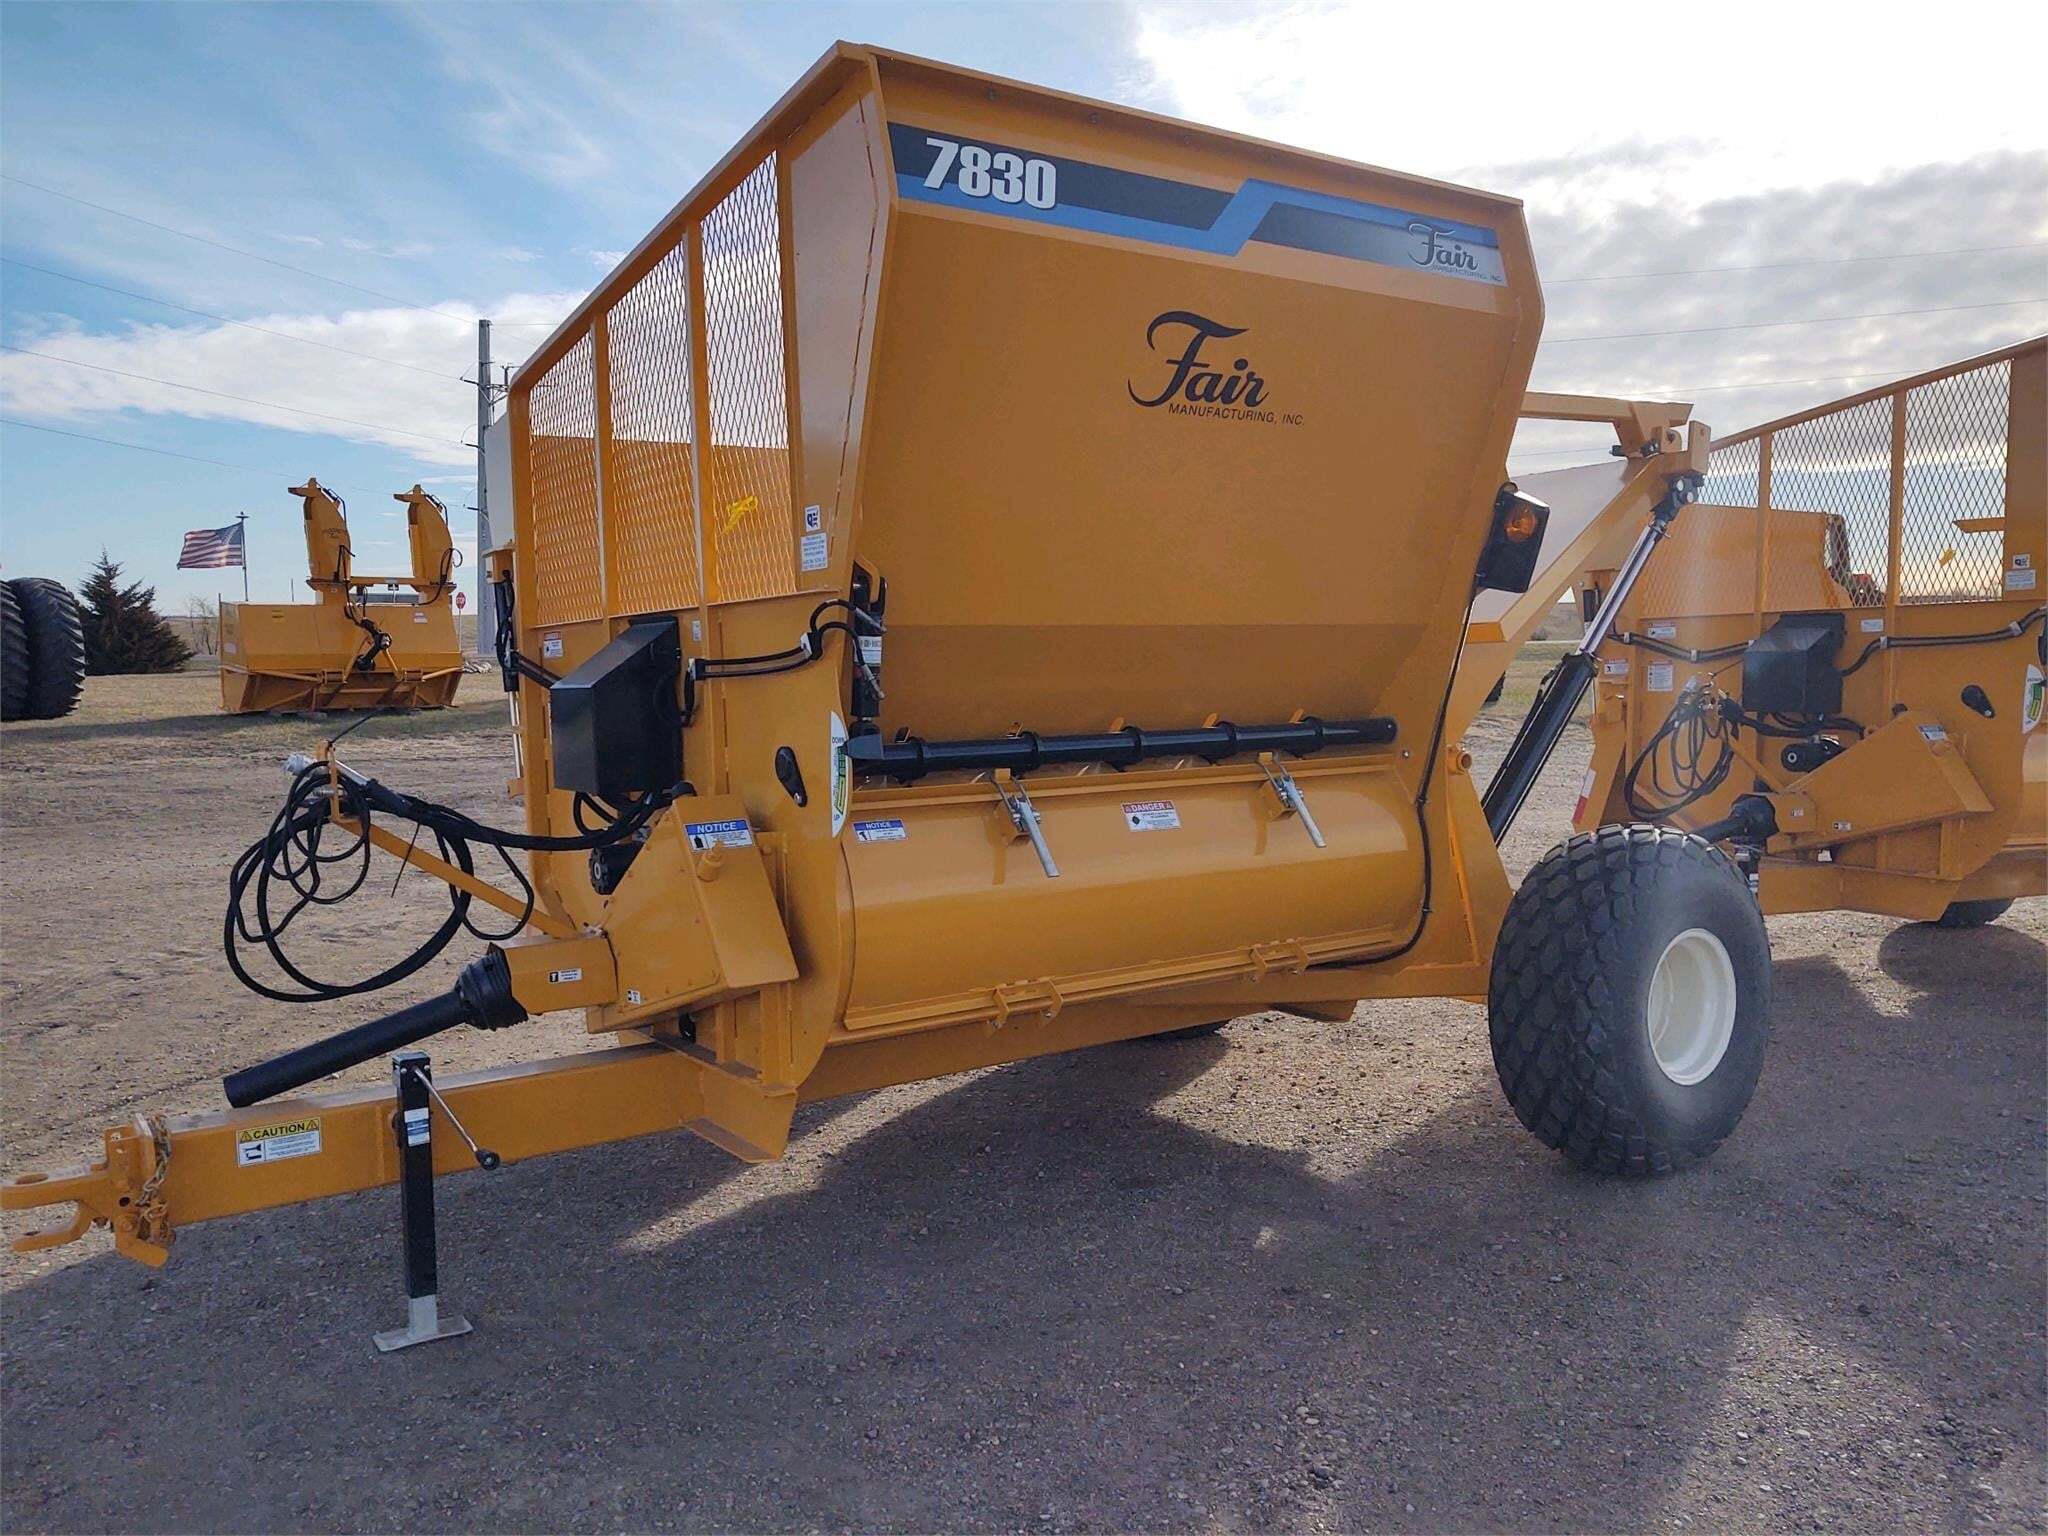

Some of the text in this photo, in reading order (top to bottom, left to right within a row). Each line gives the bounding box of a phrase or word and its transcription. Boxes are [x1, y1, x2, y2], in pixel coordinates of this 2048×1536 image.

[923, 136, 1057, 209] 7830
[1407, 222, 1480, 271] Fair
[1127, 310, 1270, 408] Fair
[1168, 403, 1278, 425] MANUFACTURING,
[1132, 802, 1165, 812] DANGER
[696, 821, 737, 833] NOTICE
[866, 820, 891, 830] NOTICE
[253, 1122, 305, 1140] CAUTION
